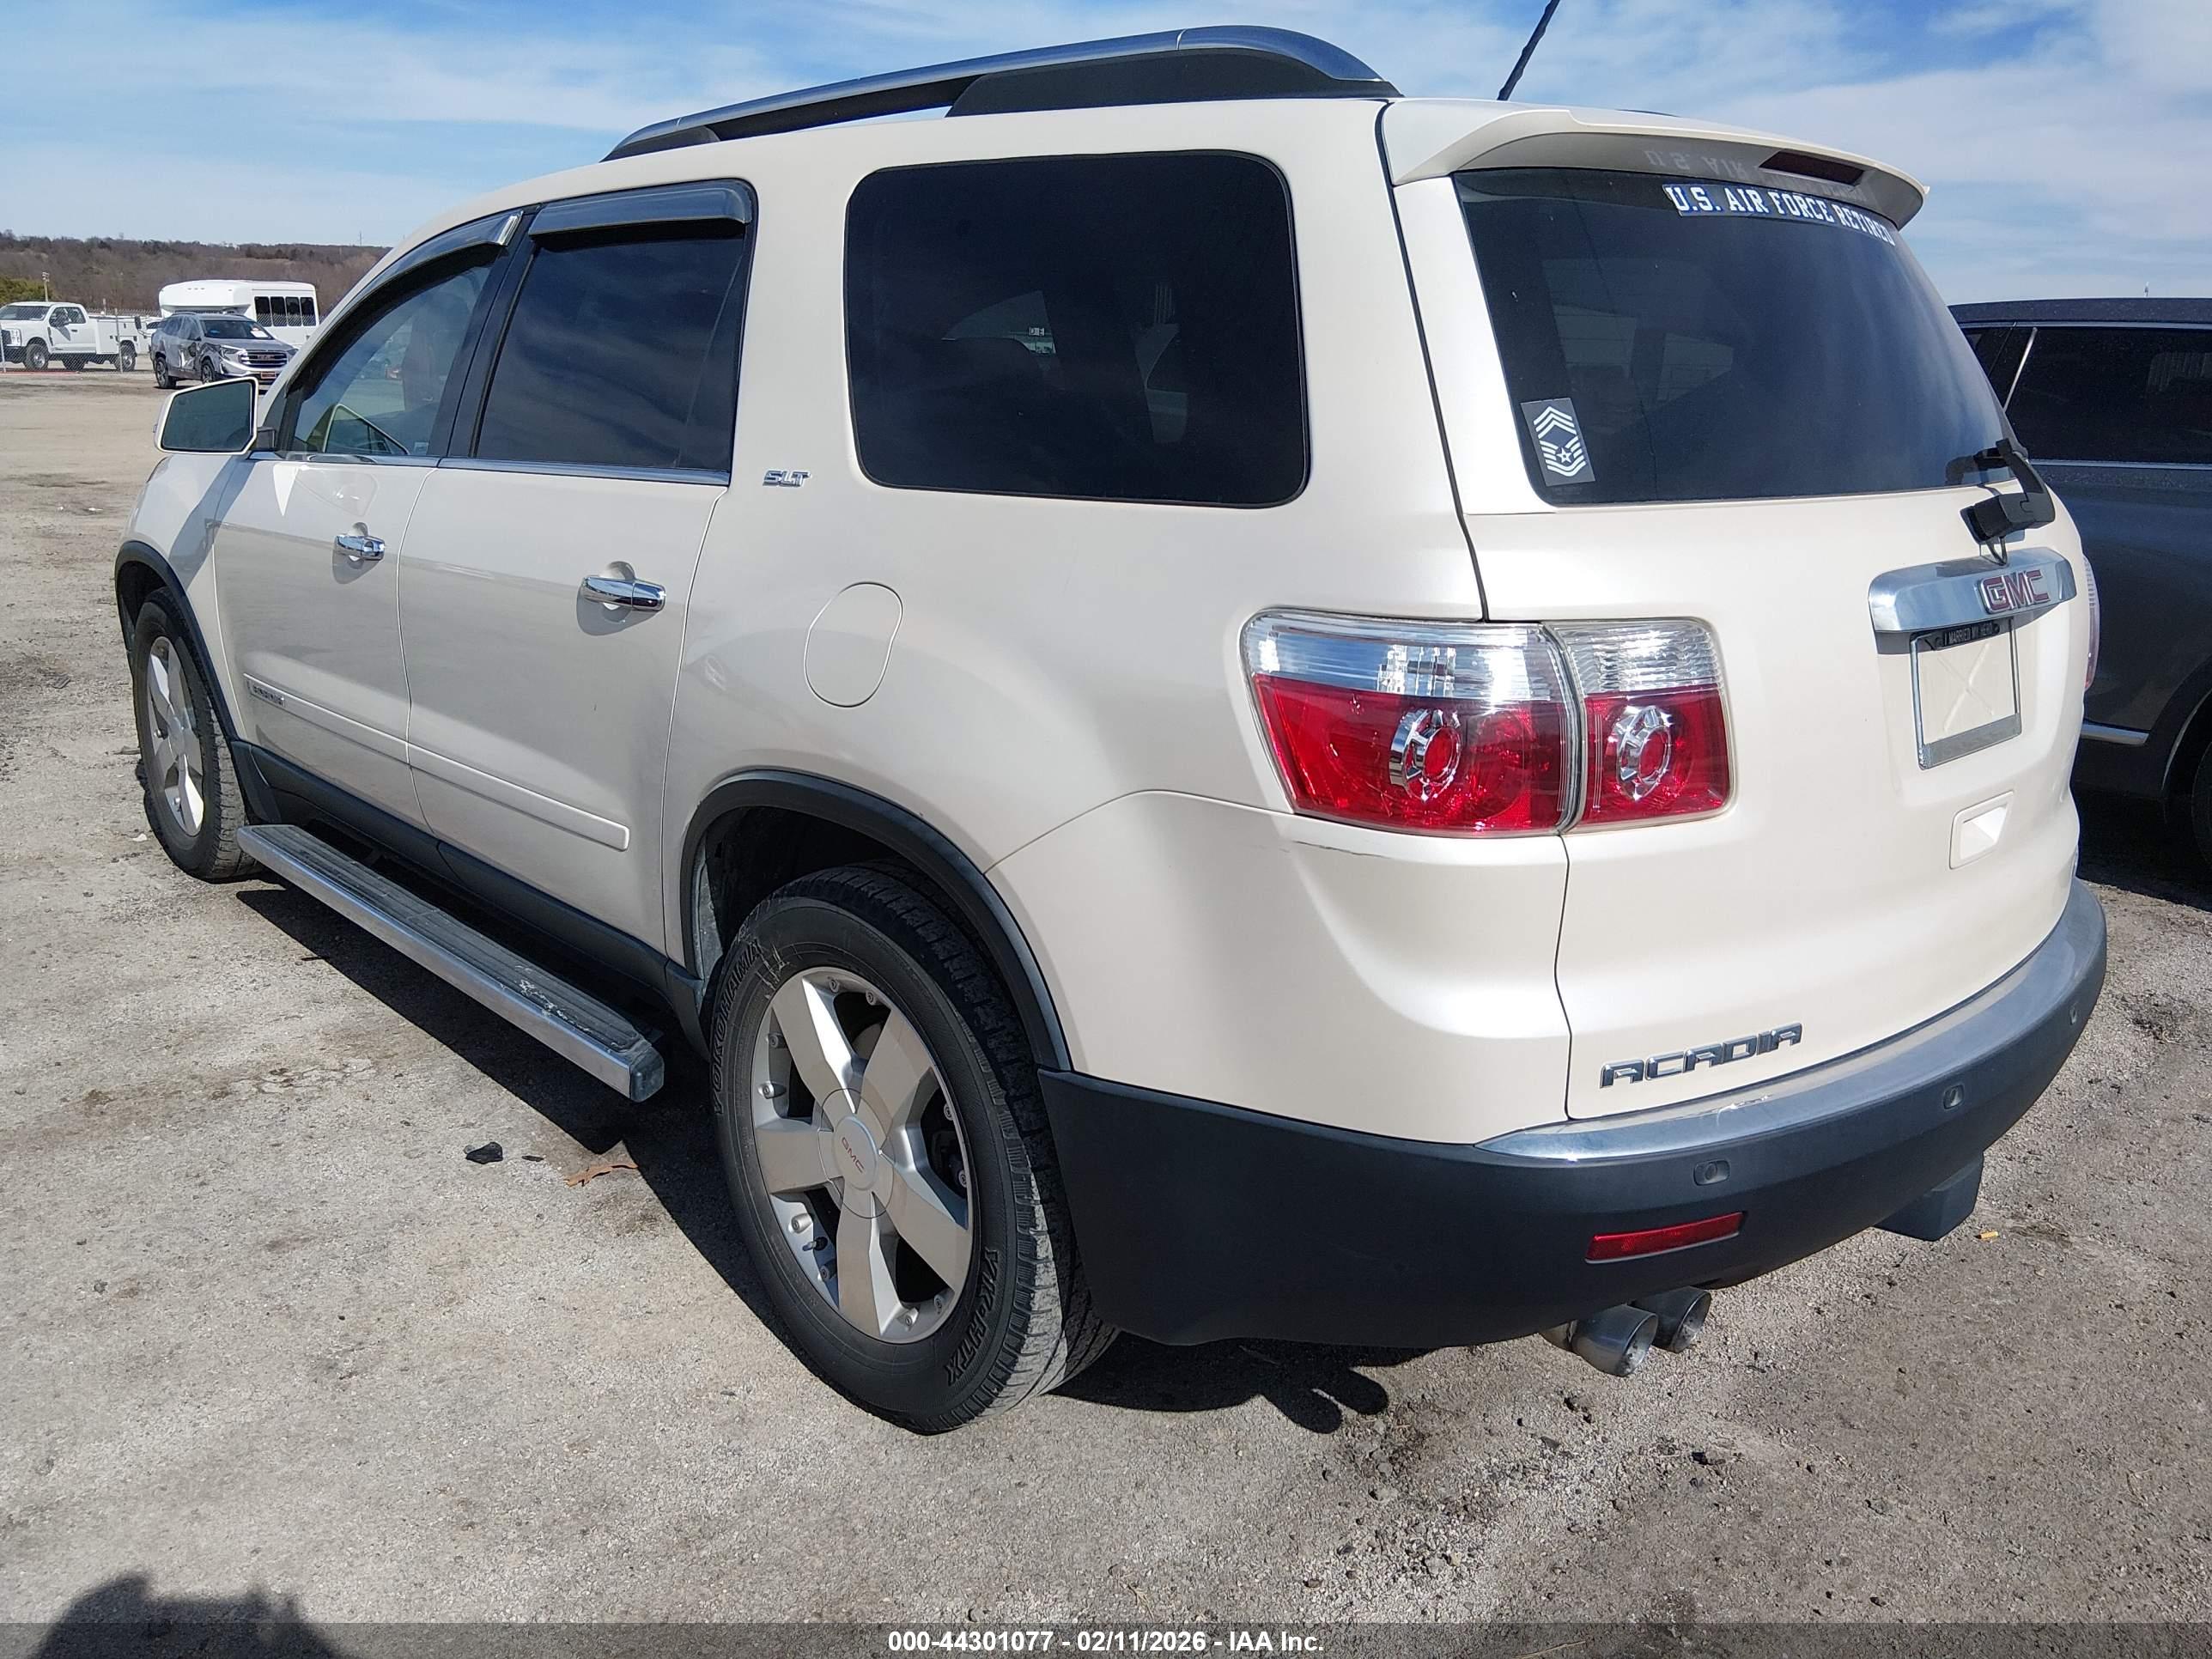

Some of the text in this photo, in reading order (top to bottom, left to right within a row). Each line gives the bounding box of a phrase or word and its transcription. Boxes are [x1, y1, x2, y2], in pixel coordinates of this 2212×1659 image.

[1665, 185, 1722, 213] U.S.
[1725, 188, 1769, 215] AIR
[1767, 191, 1835, 224] FORCE
[1832, 203, 1896, 247] RETIRED
[763, 469, 811, 488] SLT
[1981, 568, 2051, 613] GMC
[714, 942, 762, 1115] YOKOHAMA
[1599, 1021, 1803, 1089] ACADIA
[842, 1136, 865, 1174] GMC
